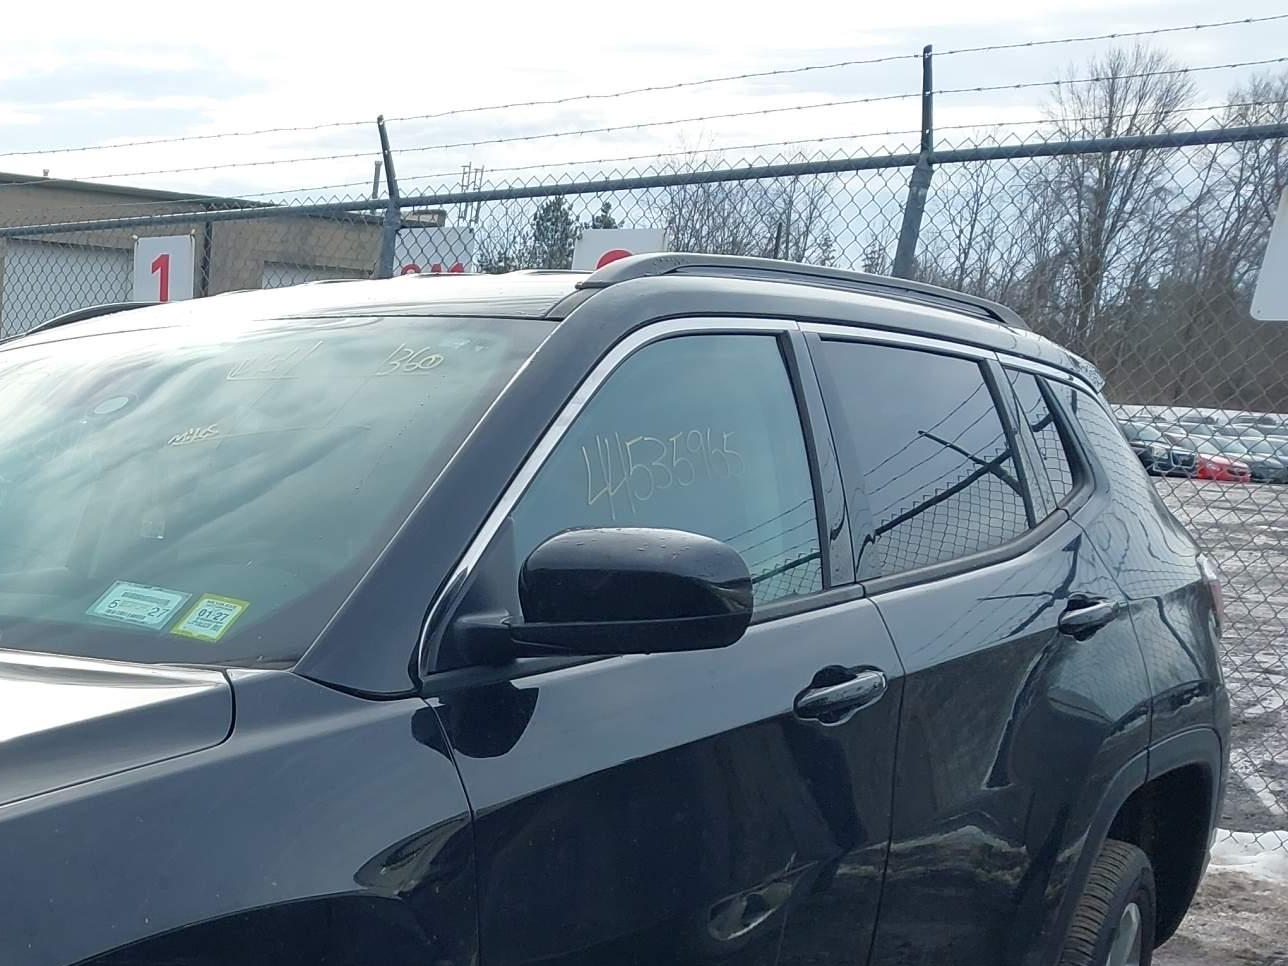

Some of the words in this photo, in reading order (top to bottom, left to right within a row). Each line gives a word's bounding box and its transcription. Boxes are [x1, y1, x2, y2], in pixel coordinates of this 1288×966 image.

[150, 253, 170, 303] 1
[582, 427, 746, 521] 44535965
[147, 606, 169, 618] 27
